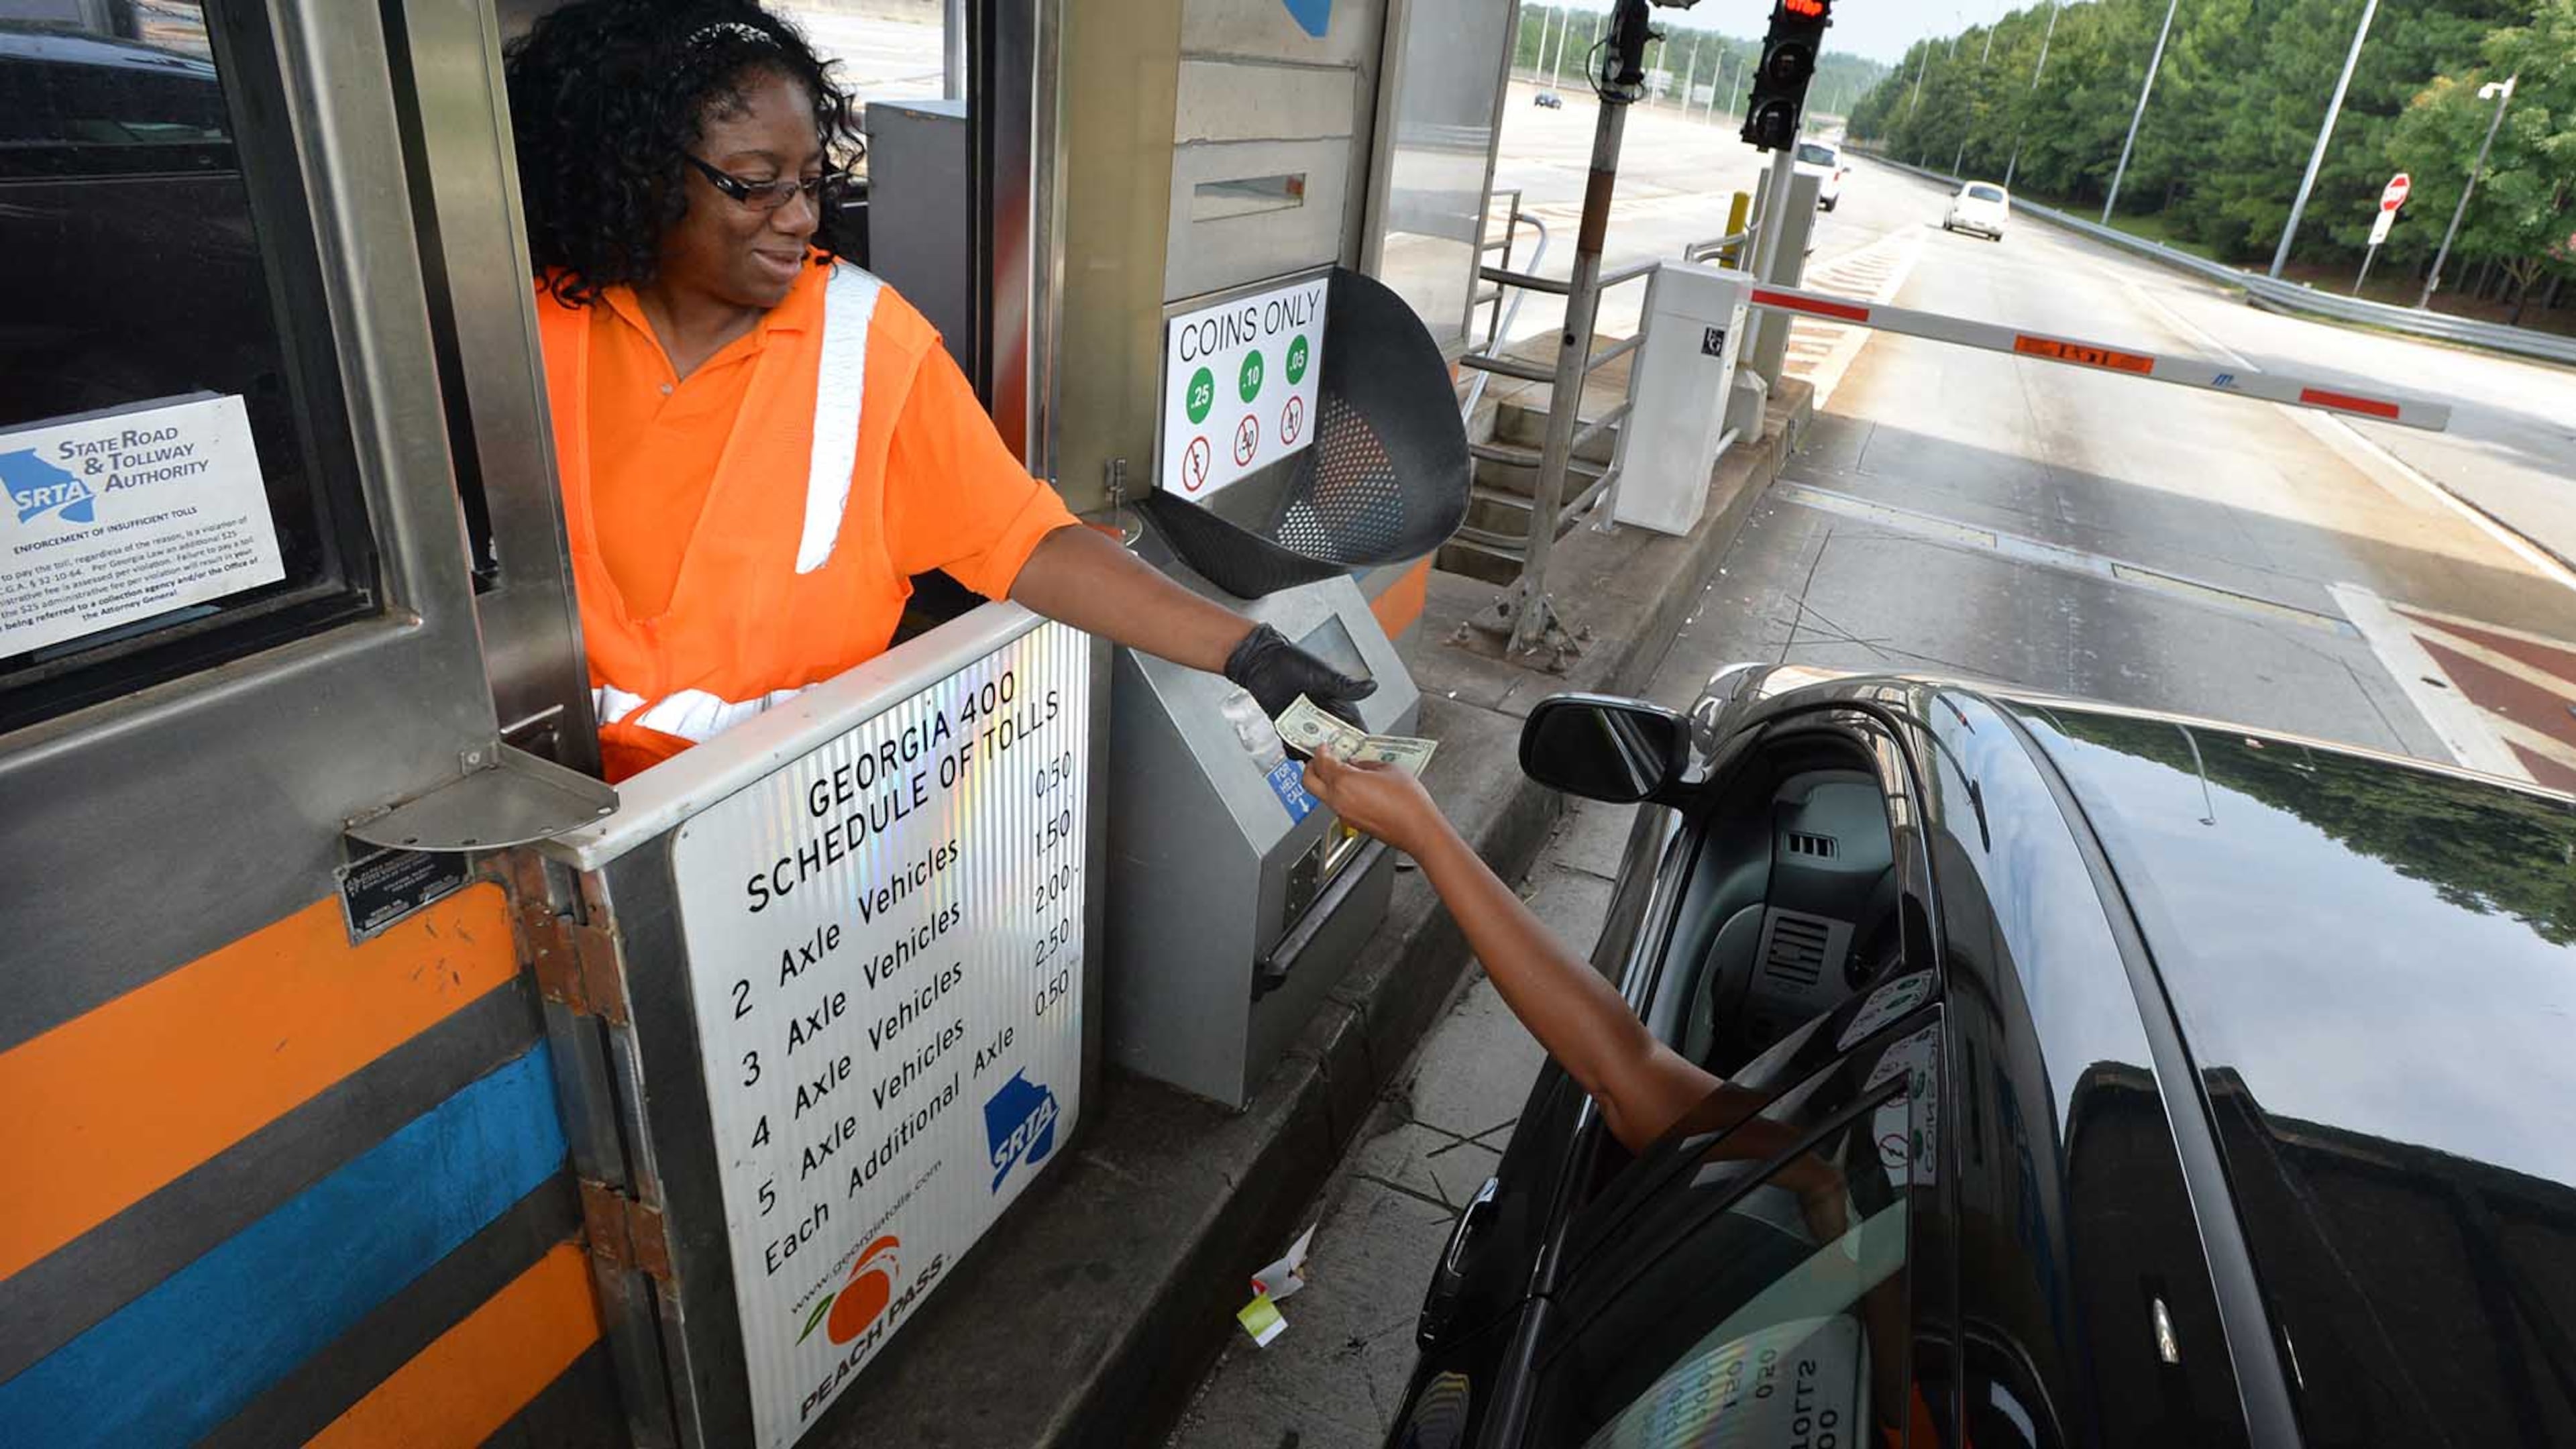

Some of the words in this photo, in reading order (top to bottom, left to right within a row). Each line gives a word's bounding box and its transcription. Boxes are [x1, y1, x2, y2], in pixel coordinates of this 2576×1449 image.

[1180, 307, 1257, 362] COINS
[1265, 288, 1321, 335] ONLY
[1191, 384, 1210, 409] .25
[1243, 366, 1260, 388] .10
[1289, 349, 1305, 371] .05
[59, 439, 118, 460] STATE
[122, 427, 178, 448] ROAD
[85, 458, 104, 476] &
[110, 443, 196, 471] TOLLWAY
[105, 460, 210, 492] AUTHORITY
[13, 531, 89, 555] ENFORCEMENT
[92, 527, 104, 536] OF
[107, 513, 169, 533] INSUFFICIENT
[171, 506, 197, 518] TOLLS
[15, 480, 87, 511] SRTA
[809, 710, 951, 818] GEORGIA
[961, 671, 1016, 724] 400
[1274, 763, 1292, 782] FOR
[747, 771, 929, 914] SCHEDULE
[940, 742, 975, 788] OF
[983, 690, 1059, 761] TOLLS
[1279, 771, 1298, 794] HELP
[731, 979, 753, 1020] 2
[780, 921, 841, 987] Axle
[859, 838, 959, 925] Vehicles
[1036, 750, 1071, 799] 0.50
[741, 1049, 761, 1088] 3
[786, 989, 847, 1056] Axle
[863, 900, 961, 991] Vehicles
[1036, 809, 1071, 858] 1.50
[751, 1114, 771, 1149] 4
[794, 1053, 852, 1121] Axle
[868, 959, 963, 1054] Vehicles
[1036, 864, 1070, 915] 2.00
[757, 1180, 777, 1217] 5
[800, 1114, 857, 1182] Axle
[871, 1016, 965, 1113] Vehicles
[1036, 917, 1069, 967] 2.50
[765, 1199, 830, 1278] Each
[848, 1071, 960, 1200] Additional
[972, 1025, 1014, 1079] Axle
[1035, 969, 1069, 1016] 0.50
[994, 1095, 1054, 1170] SRTA
[792, 1159, 943, 1315] www.georgiatolls.com
[800, 1318, 884, 1424] PEACH
